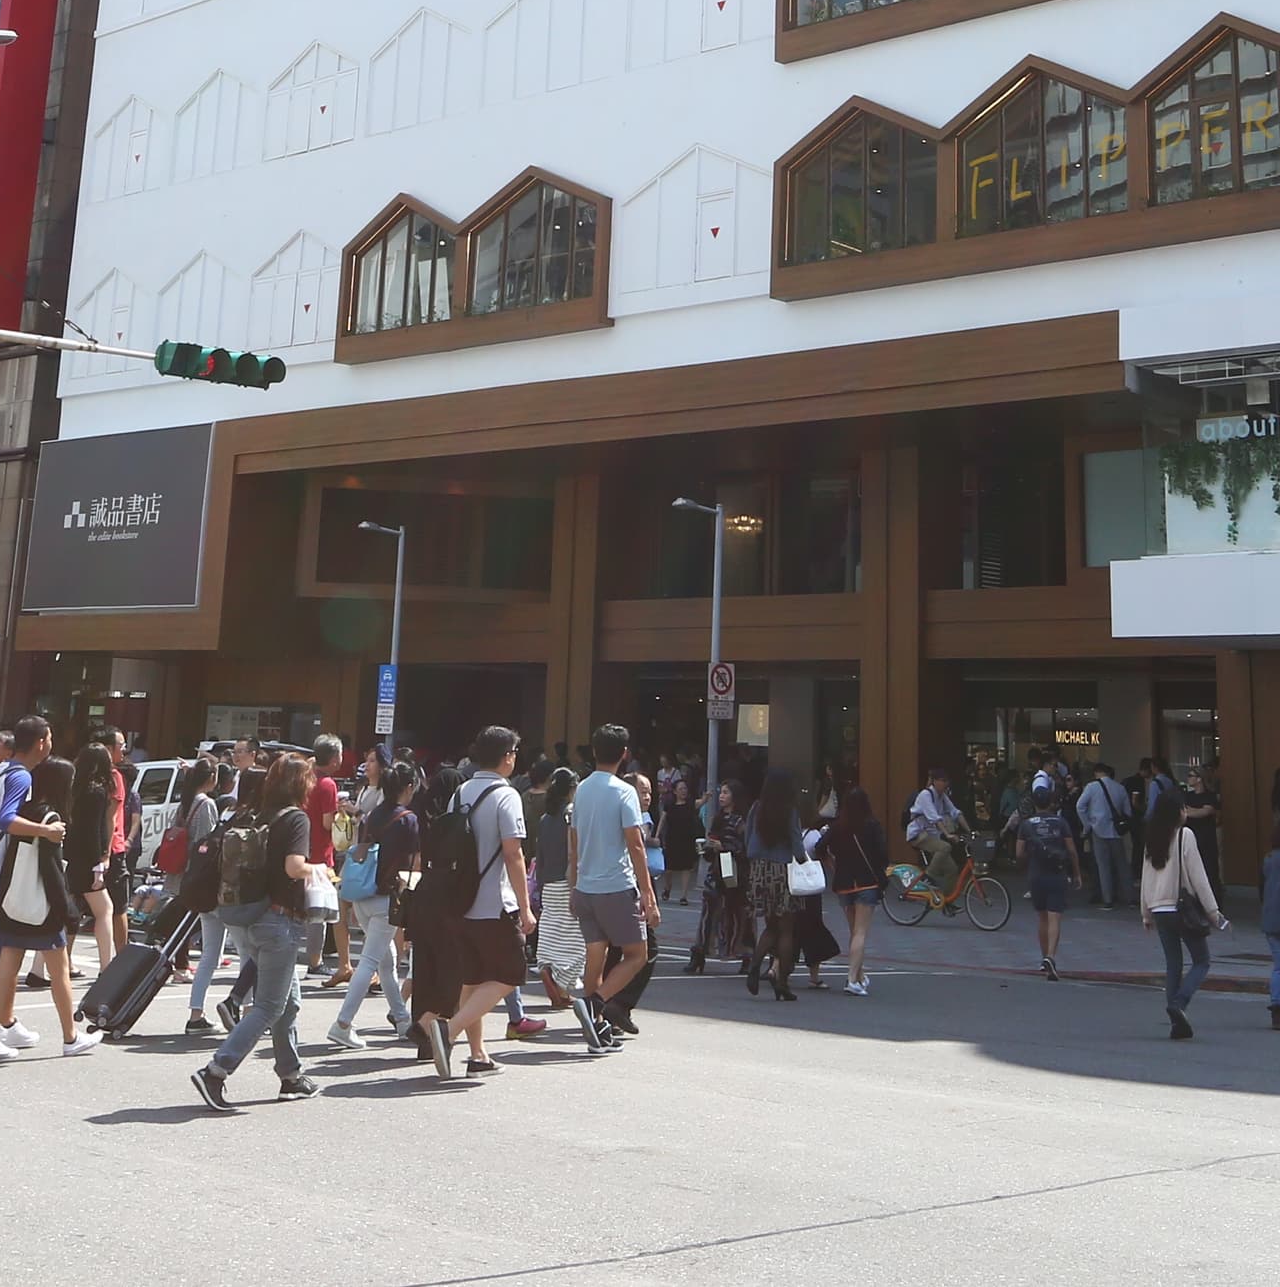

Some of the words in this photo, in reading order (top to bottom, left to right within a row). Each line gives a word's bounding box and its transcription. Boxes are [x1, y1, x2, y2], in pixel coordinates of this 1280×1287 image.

[1199, 415, 1277, 442] about
[89, 492, 163, 528] 誠品書店
[88, 531, 97, 542] the
[1055, 730, 1089, 745] MICHAEL
